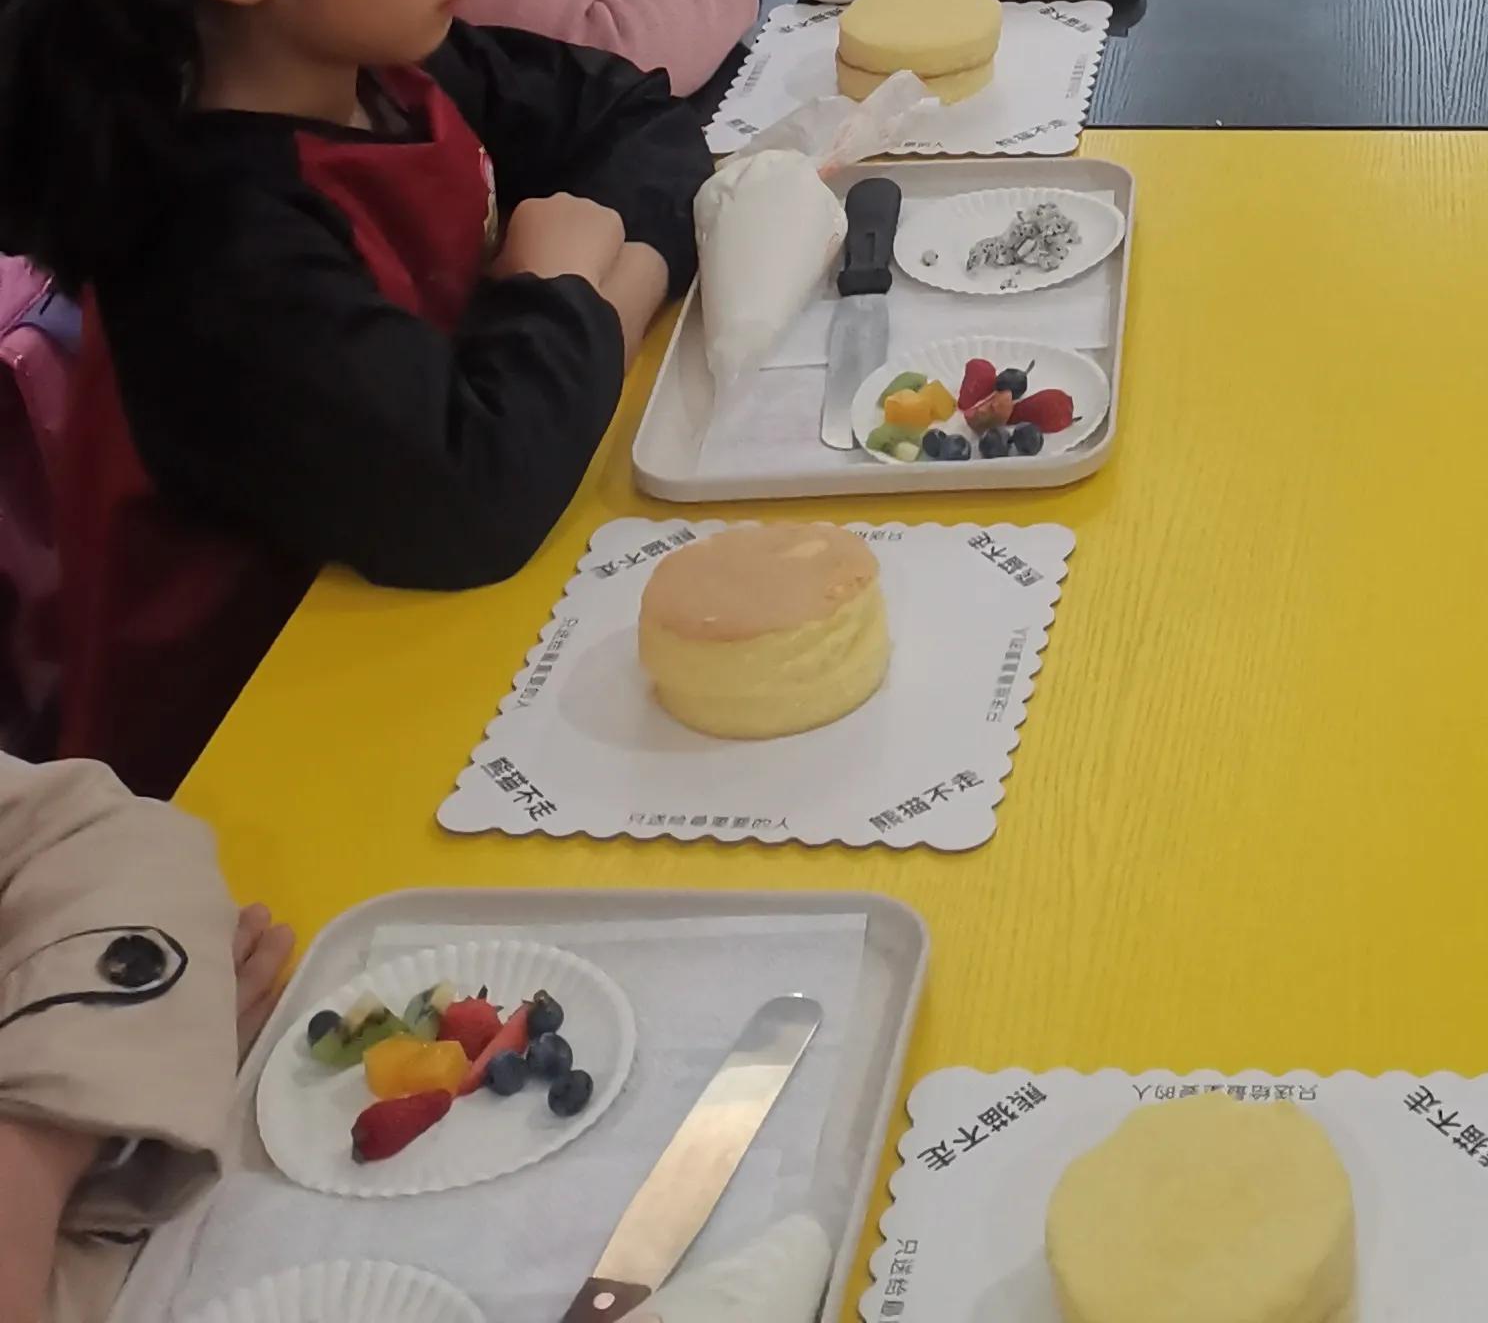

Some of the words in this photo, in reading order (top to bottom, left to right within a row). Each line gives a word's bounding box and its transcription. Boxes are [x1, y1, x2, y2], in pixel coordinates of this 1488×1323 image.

[480, 756, 558, 822] 熊猫不走
[869, 769, 985, 834] 熊猫不走
[1131, 1083, 1320, 1102] 只送给最要的人
[916, 1081, 1048, 1172] 熊猫不走
